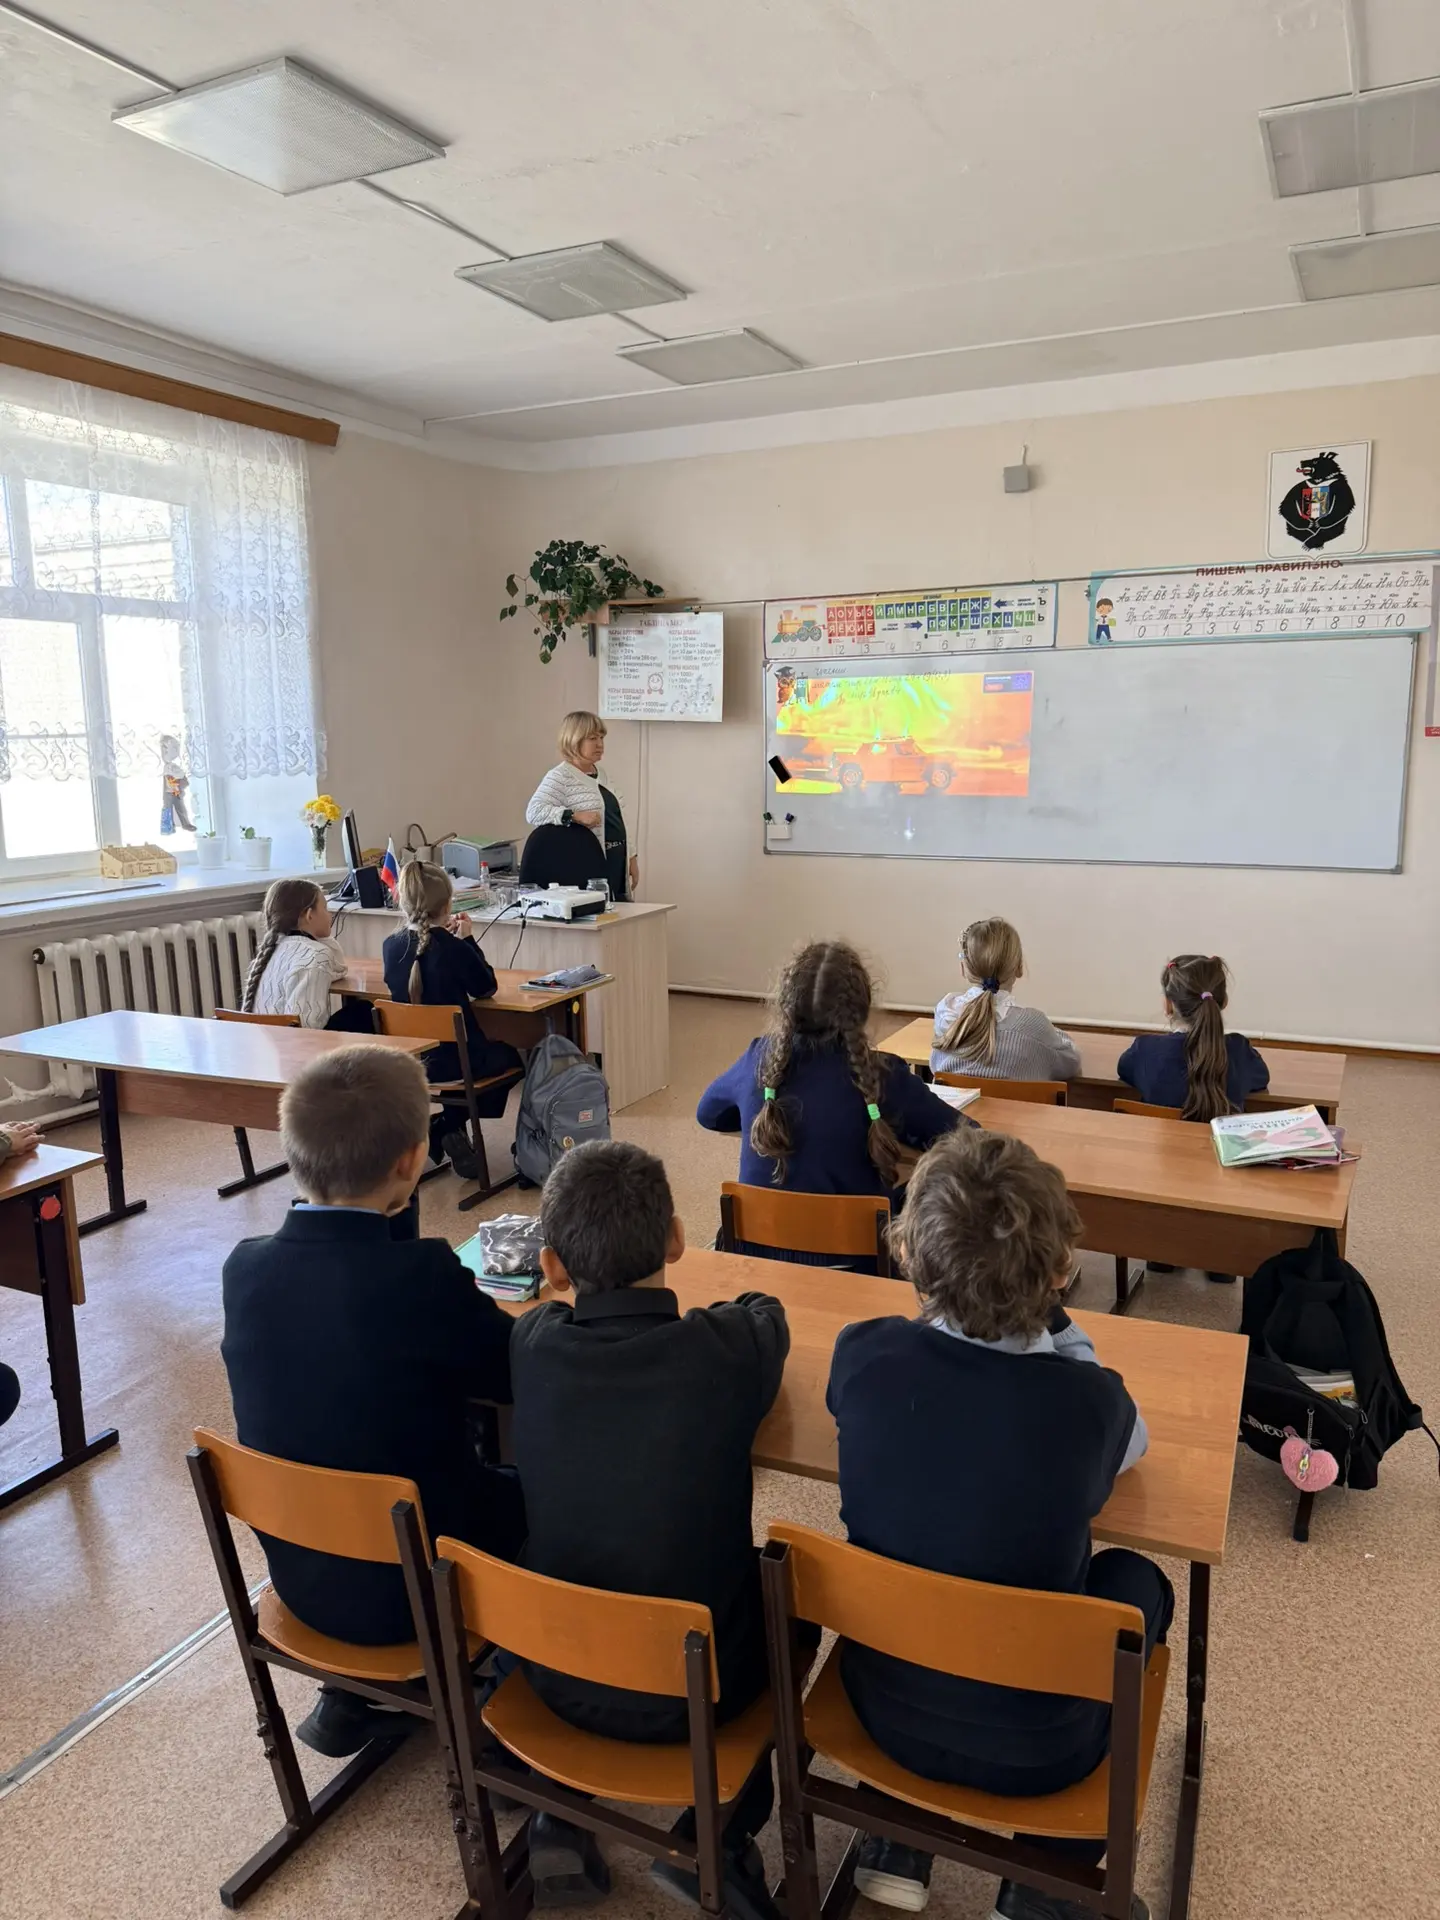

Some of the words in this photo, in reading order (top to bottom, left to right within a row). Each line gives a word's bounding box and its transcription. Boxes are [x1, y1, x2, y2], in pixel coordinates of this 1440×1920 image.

[1196, 566, 1246, 576] ПИШЕМ
[1116, 592, 1131, 603] Аа
[1136, 590, 1152, 602] Бб
[1153, 590, 1167, 600] Вв
[1186, 588, 1200, 602] Дд
[1232, 585, 1256, 596] Жж
[1258, 584, 1270, 598] Зз
[1275, 582, 1288, 594] Ии
[1292, 581, 1307, 592] Йй
[1310, 581, 1325, 592] Кк
[1328, 580, 1346, 590] Лл
[1349, 578, 1372, 589] Мм
[1376, 576, 1392, 588] Нн
[1396, 576, 1409, 587] Оо
[1410, 574, 1430, 587] Пп
[828, 610, 836, 618] А
[838, 610, 844, 618] О
[848, 609, 853, 618] У
[866, 608, 873, 616] Э
[886, 607, 894, 616] Л
[896, 606, 904, 615] М
[908, 606, 914, 614] Н
[918, 605, 925, 614] Р
[929, 604, 936, 613] Б
[940, 604, 946, 612] В
[950, 603, 956, 612] Г
[960, 602, 969, 612] Д
[971, 601, 980, 610] Ж
[984, 601, 990, 610] З
[1038, 597, 1046, 606] Ъ
[829, 624, 836, 632] Я
[858, 624, 864, 632] И
[867, 623, 874, 632] Е
[929, 619, 936, 628] П
[938, 618, 946, 628] Ф
[950, 618, 956, 627] К
[961, 618, 968, 626] Т
[971, 616, 980, 626] Ш
[983, 616, 990, 625] С
[994, 616, 1000, 624] Х
[1004, 616, 1012, 626] Ц
[1038, 614, 1045, 622] Ь
[1138, 625, 1146, 638] 0
[1163, 624, 1170, 636] 1
[1184, 623, 1192, 636] 2
[1206, 622, 1216, 634] 3
[1233, 620, 1240, 633] 4
[1254, 620, 1264, 632] 5
[1280, 618, 1289, 632] 6
[1305, 617, 1314, 630] 7
[1330, 616, 1340, 629] 8
[1356, 615, 1366, 628] 9
[1384, 613, 1406, 628] 10
